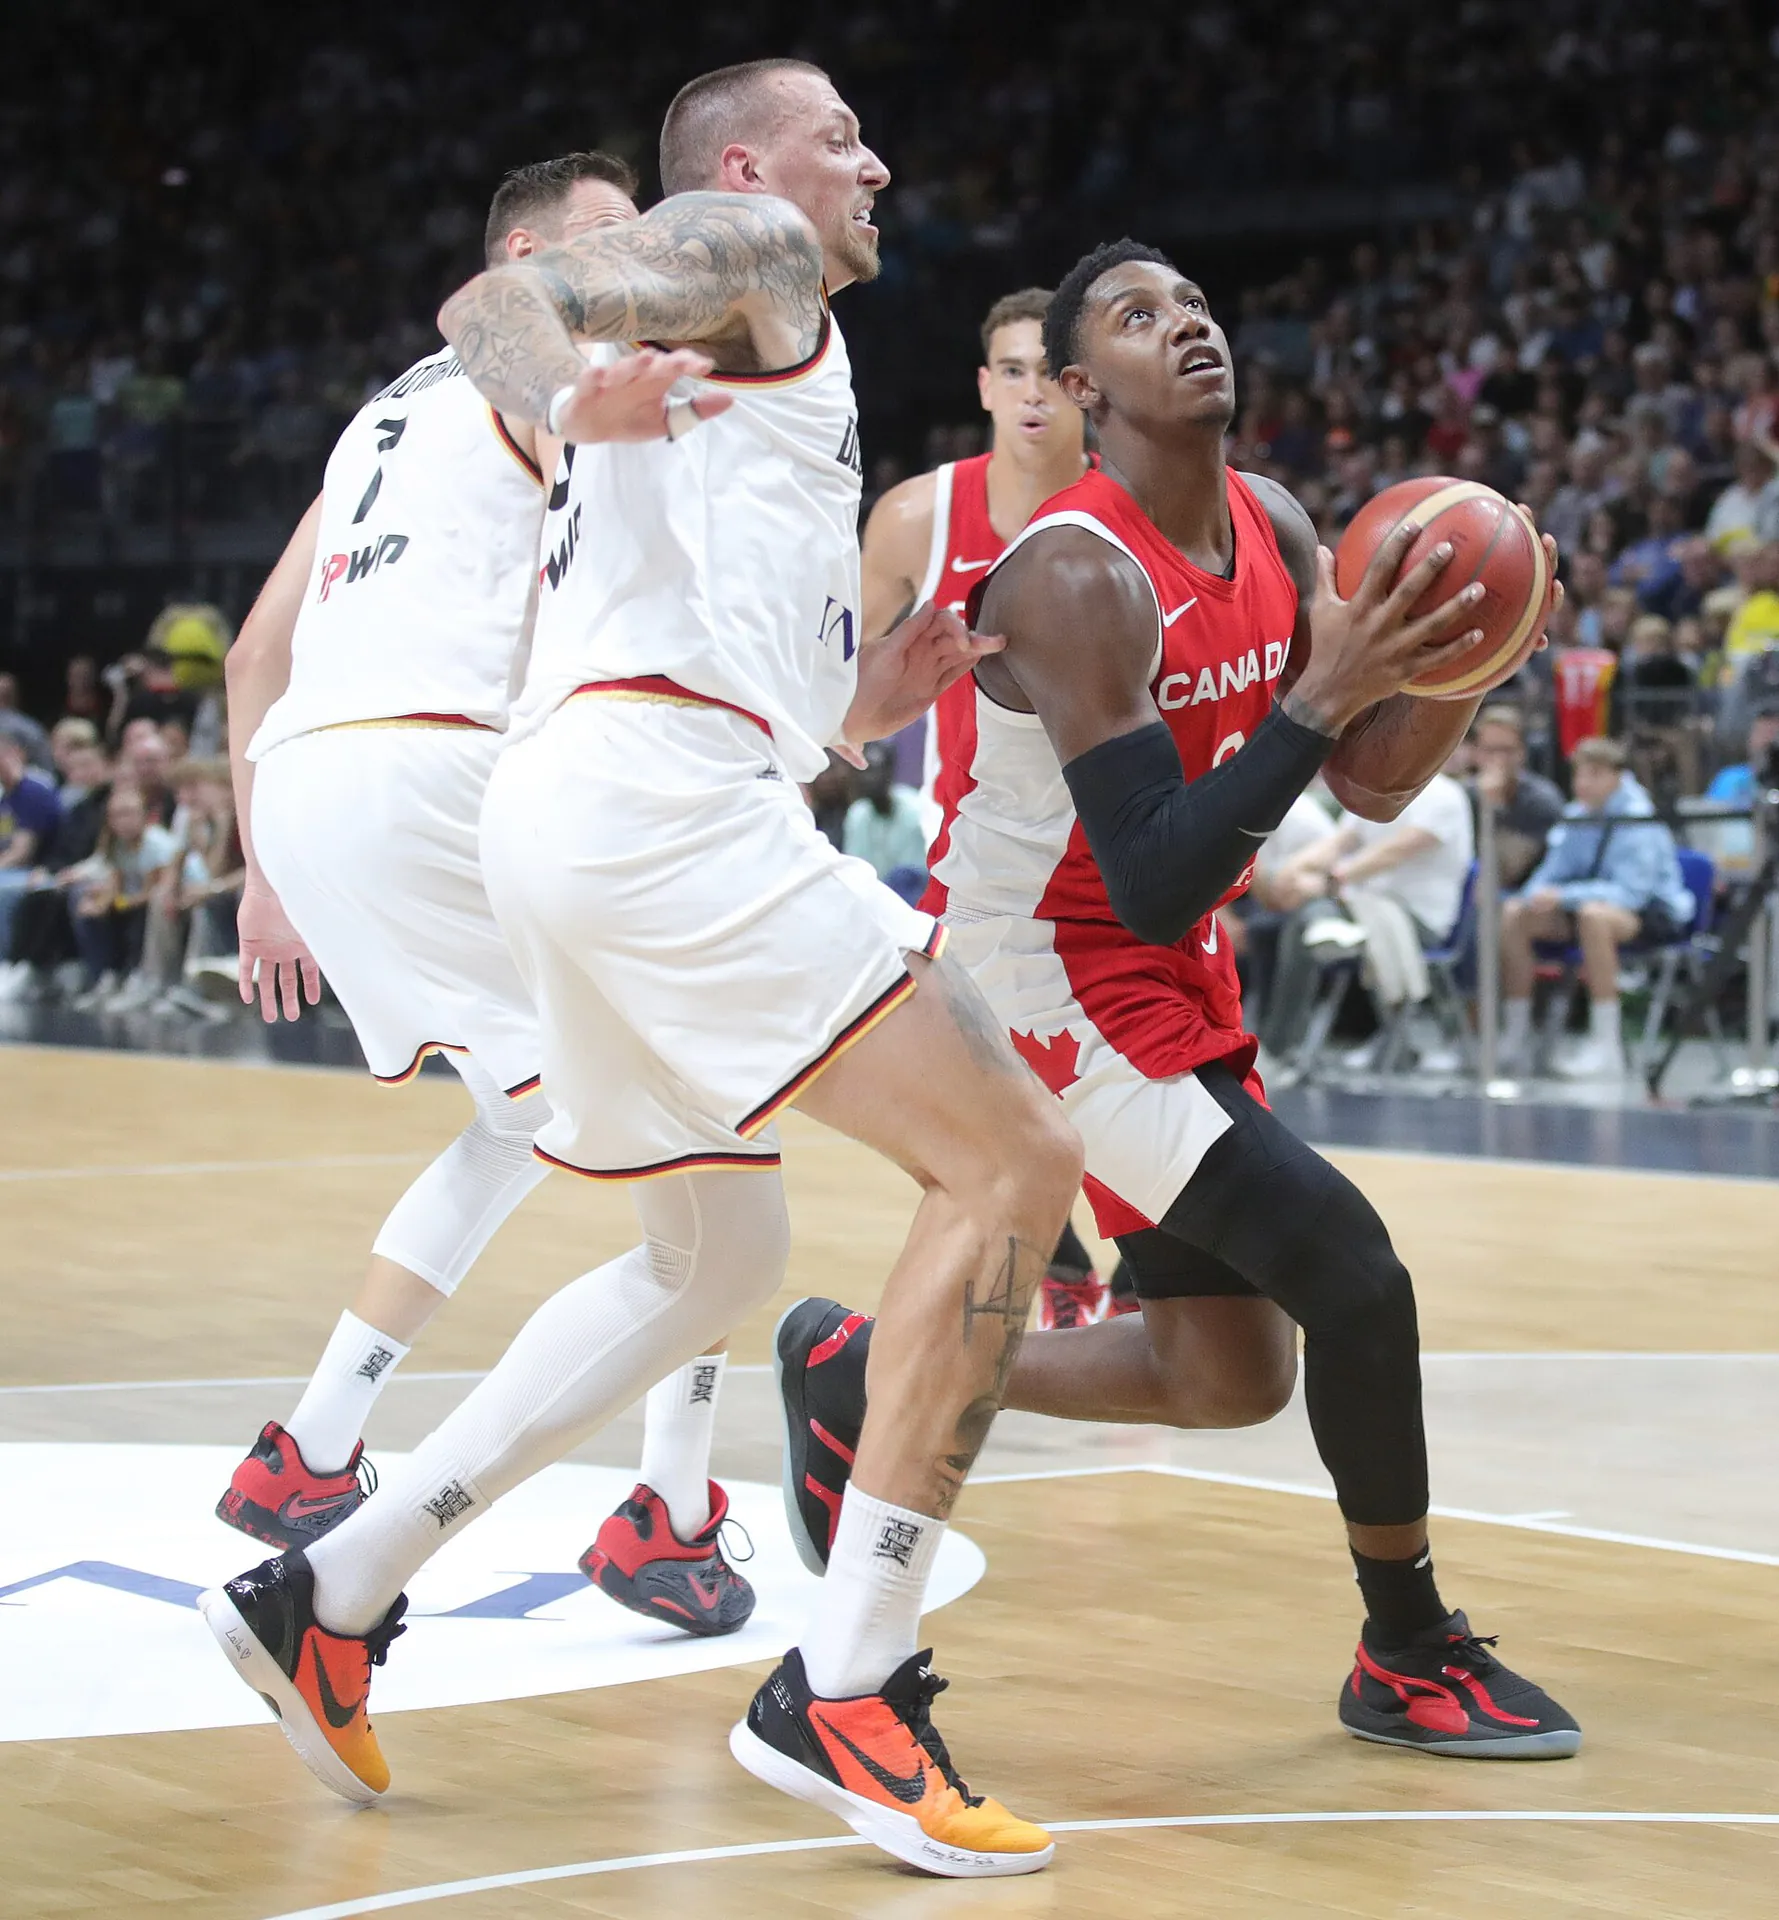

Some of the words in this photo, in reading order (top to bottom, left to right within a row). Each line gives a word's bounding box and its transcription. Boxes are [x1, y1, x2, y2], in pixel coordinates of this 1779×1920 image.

[352, 413, 408, 525] 7
[422, 1479, 476, 1530] PEAK
[873, 1515, 923, 1568] PEAK
